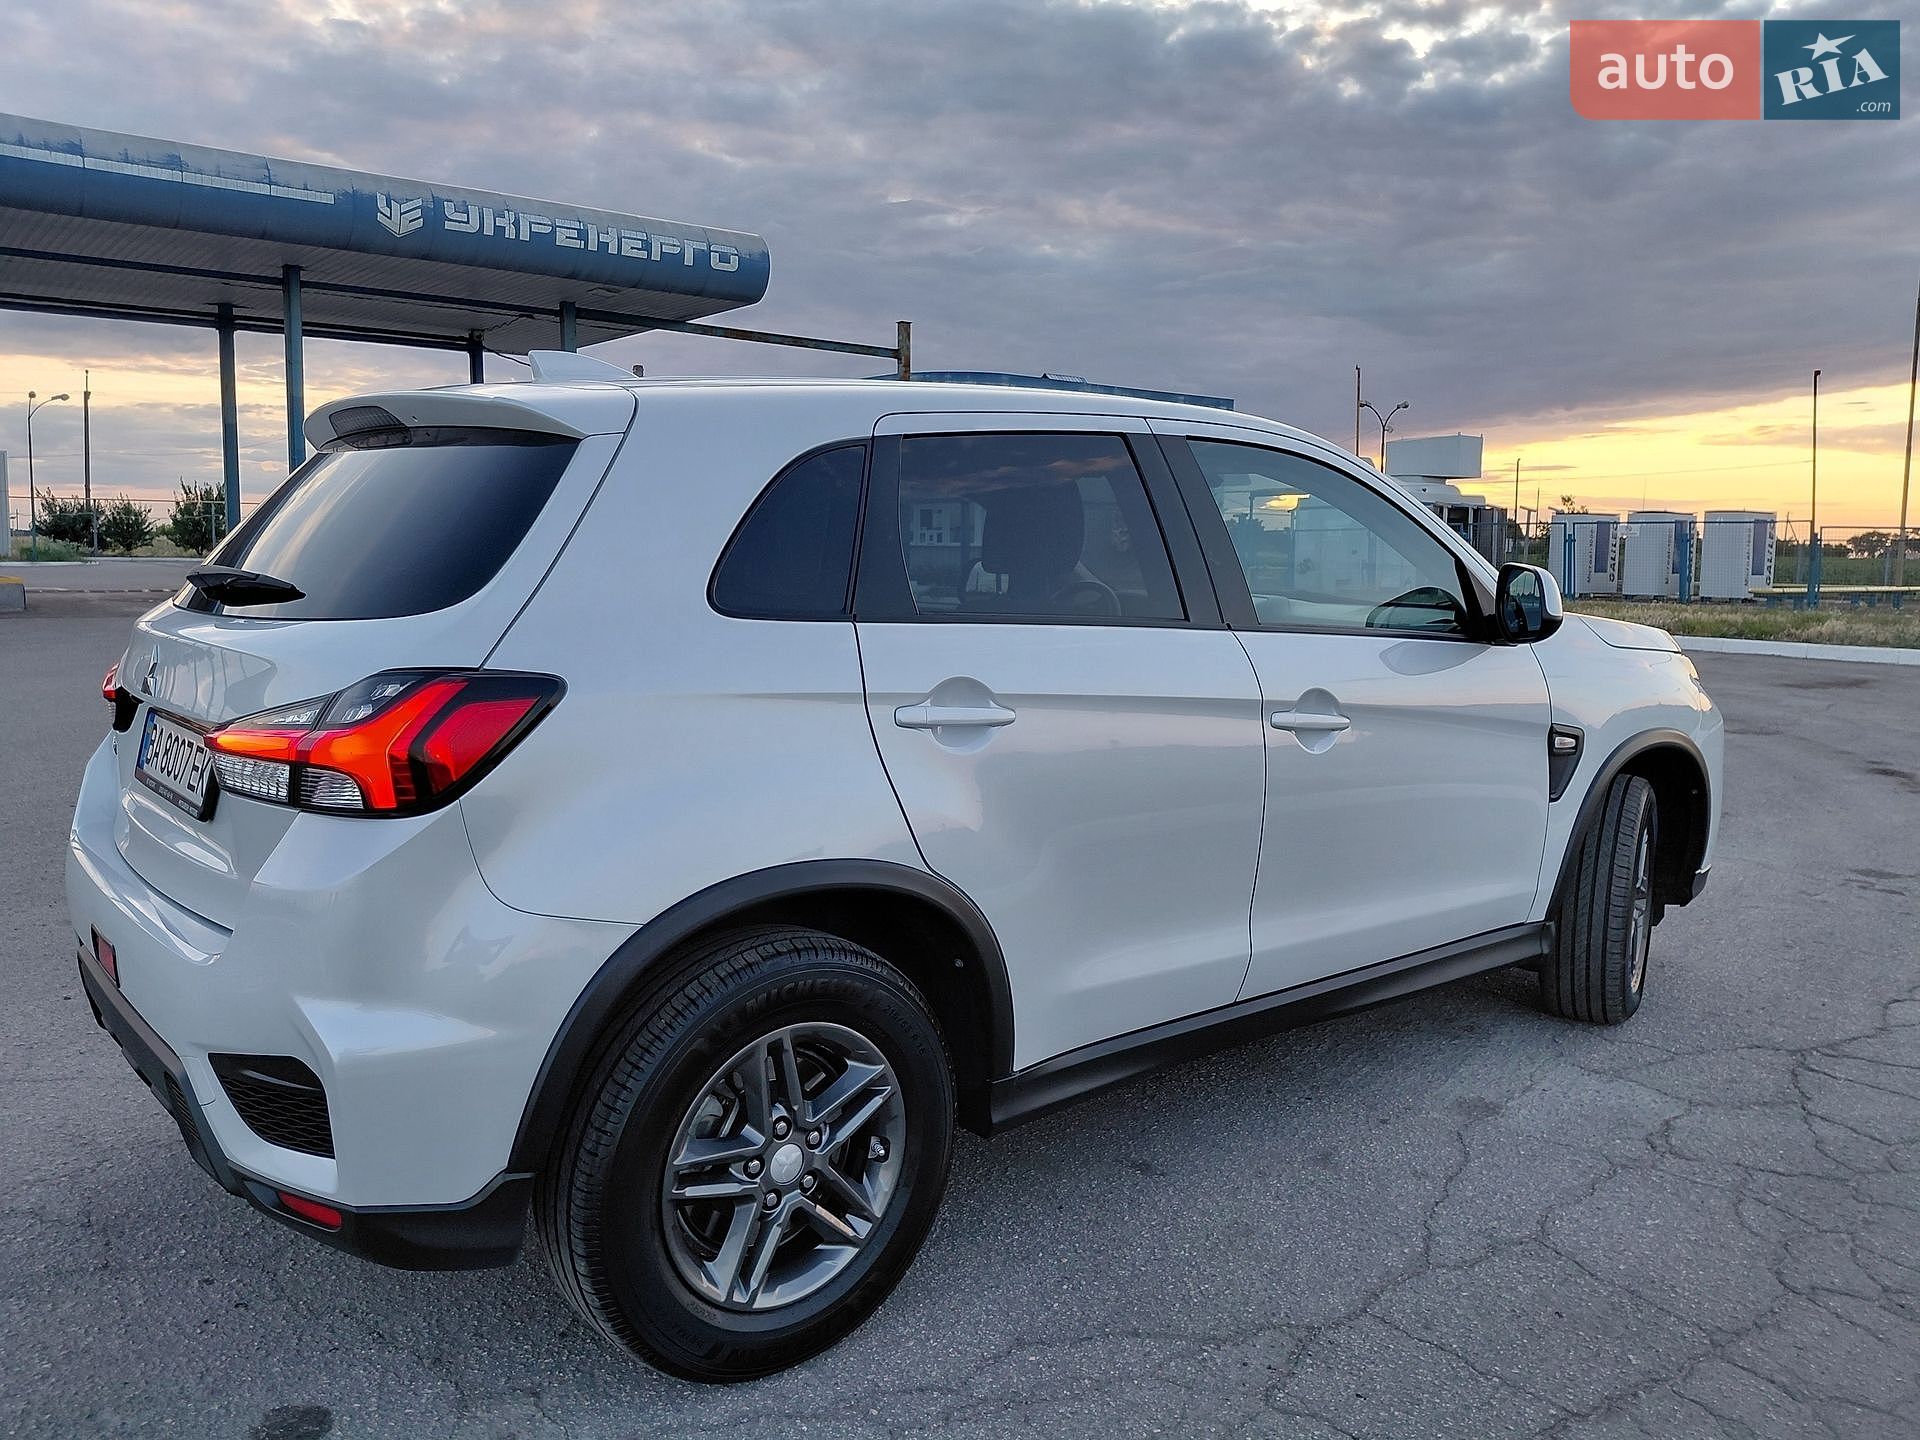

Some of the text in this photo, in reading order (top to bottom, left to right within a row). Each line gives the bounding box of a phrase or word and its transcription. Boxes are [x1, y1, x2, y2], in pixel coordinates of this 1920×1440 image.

[443, 199, 740, 273] УКРЕНЕРГО
[160, 732, 195, 785] 8007
[186, 744, 212, 798] EK
